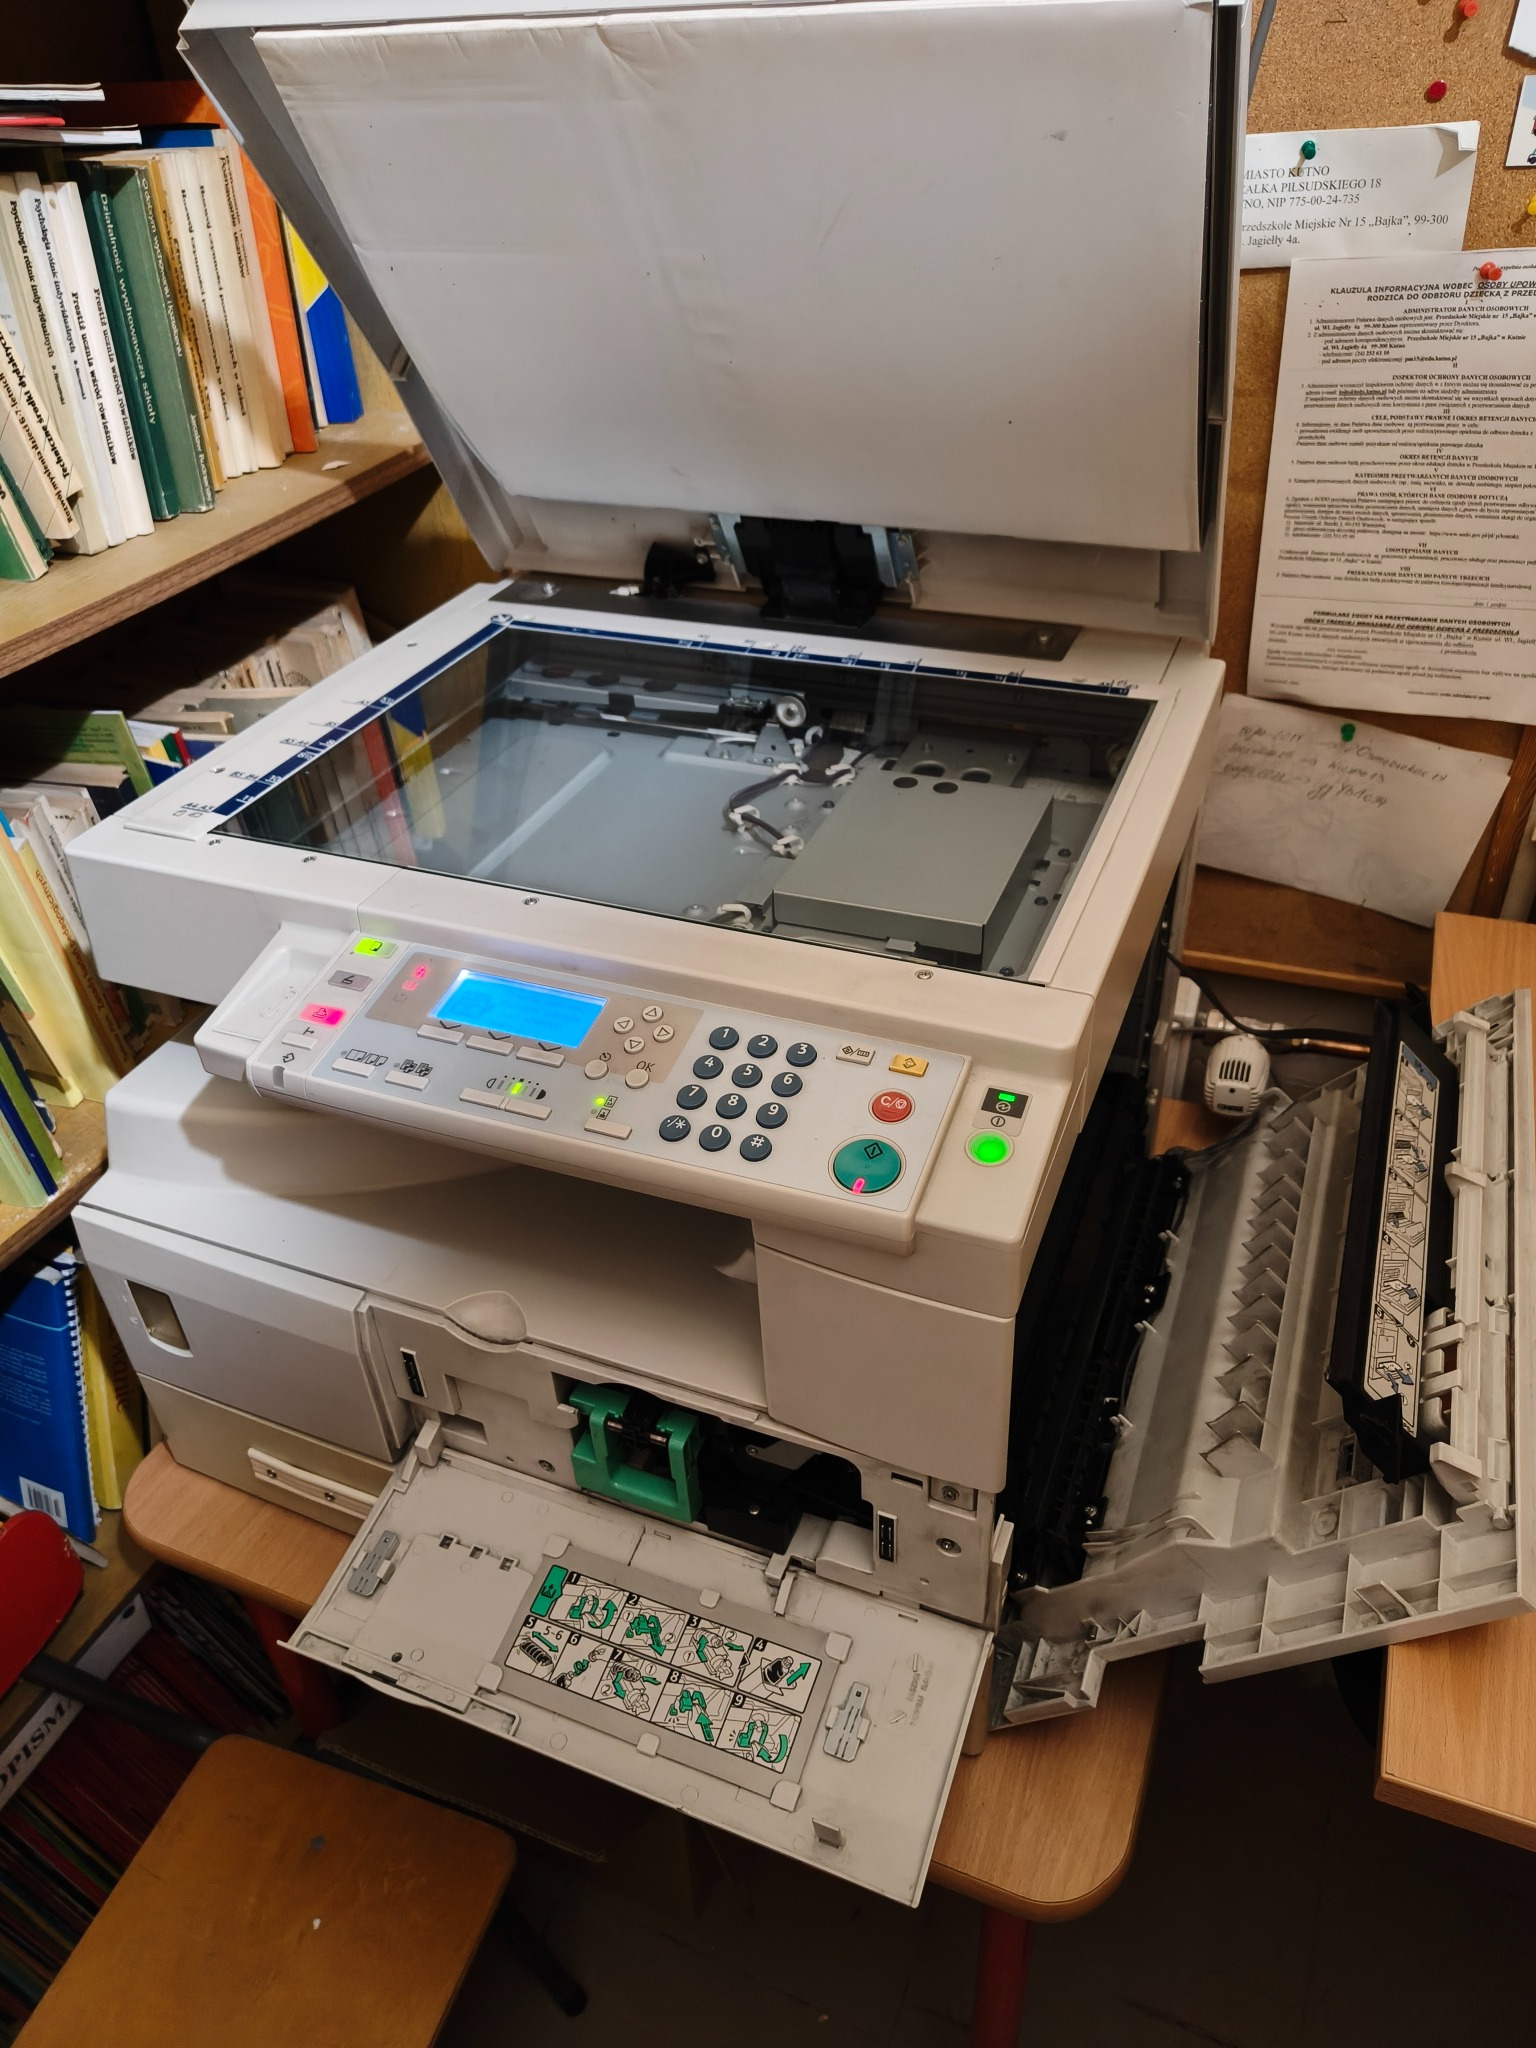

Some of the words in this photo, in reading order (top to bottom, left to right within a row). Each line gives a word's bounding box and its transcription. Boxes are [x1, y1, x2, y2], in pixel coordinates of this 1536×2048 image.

[1243, 168, 1285, 180] MIASTO
[1288, 166, 1330, 178] KUTNO
[1370, 178, 1382, 188] 18
[215, 156, 242, 227] Poznawanie
[230, 231, 248, 278] uczniów
[1242, 198, 1264, 209] NO,
[1267, 197, 1287, 208] NIP
[1290, 194, 1360, 207] 775-00-24-735
[1242, 219, 1292, 232] rzedszkole
[1294, 218, 1336, 232] Miejskie
[1339, 217, 1351, 227] Nr
[1355, 216, 1366, 227] 15
[1414, 214, 1449, 225] 99-300
[1286, 234, 1300, 244] 4a.
[142, 190, 158, 232] dobrym
[151, 235, 171, 297] wychowaniu
[8, 199, 29, 254] Psychologia
[30, 283, 55, 358] indywidualnych
[32, 197, 52, 251] Psychologia
[51, 279, 78, 353] indywidualnych
[1330, 286, 1372, 295] KLAUZULA
[1374, 284, 1440, 293] INFORMACYJNA
[1443, 282, 1474, 290] WOBEC
[1477, 281, 1508, 289] OSOBY
[69, 291, 87, 331] Prestiż
[92, 287, 108, 327] Prestiż
[98, 192, 124, 273] Działalność
[117, 277, 148, 378] wychowawcza
[139, 381, 158, 425] szkoły
[1367, 293, 1404, 302] RODZICA
[1421, 291, 1461, 300] ODBIORU
[1464, 290, 1501, 298] DZIECKA
[79, 332, 95, 367] ucznia
[101, 328, 116, 363] ucznia
[88, 369, 103, 399] wśród
[109, 365, 123, 395] wśród
[22, 388, 45, 425] środki
[21, 423, 39, 451] dzieci
[95, 401, 119, 465] rówieśników
[115, 397, 138, 461] rówieśników
[40, 423, 71, 479] Techniczne
[32, 867, 78, 948] pedagogicznych
[722, 1028, 730, 1038] 1
[757, 1036, 769, 1047] 2
[797, 1043, 808, 1055] 3
[636, 1060, 656, 1073] OK
[704, 1057, 714, 1068] 4
[743, 1065, 754, 1076] 5
[783, 1073, 794, 1085] 6
[688, 1086, 700, 1097] 7
[727, 1094, 739, 1106] 8
[767, 1104, 779, 1116] 9
[711, 1126, 723, 1138] 0
[750, 1135, 765, 1147] #
[571, 1573, 577, 1583] 1
[629, 1595, 637, 1605] 2
[689, 1616, 698, 1626] 3
[756, 1640, 764, 1650] 4
[543, 1626, 563, 1641] 5-6
[526, 1617, 534, 1627] 5
[570, 1635, 578, 1644] 6
[614, 1650, 622, 1660] 7
[670, 1671, 679, 1682] 8
[735, 1695, 744, 1705] 9
